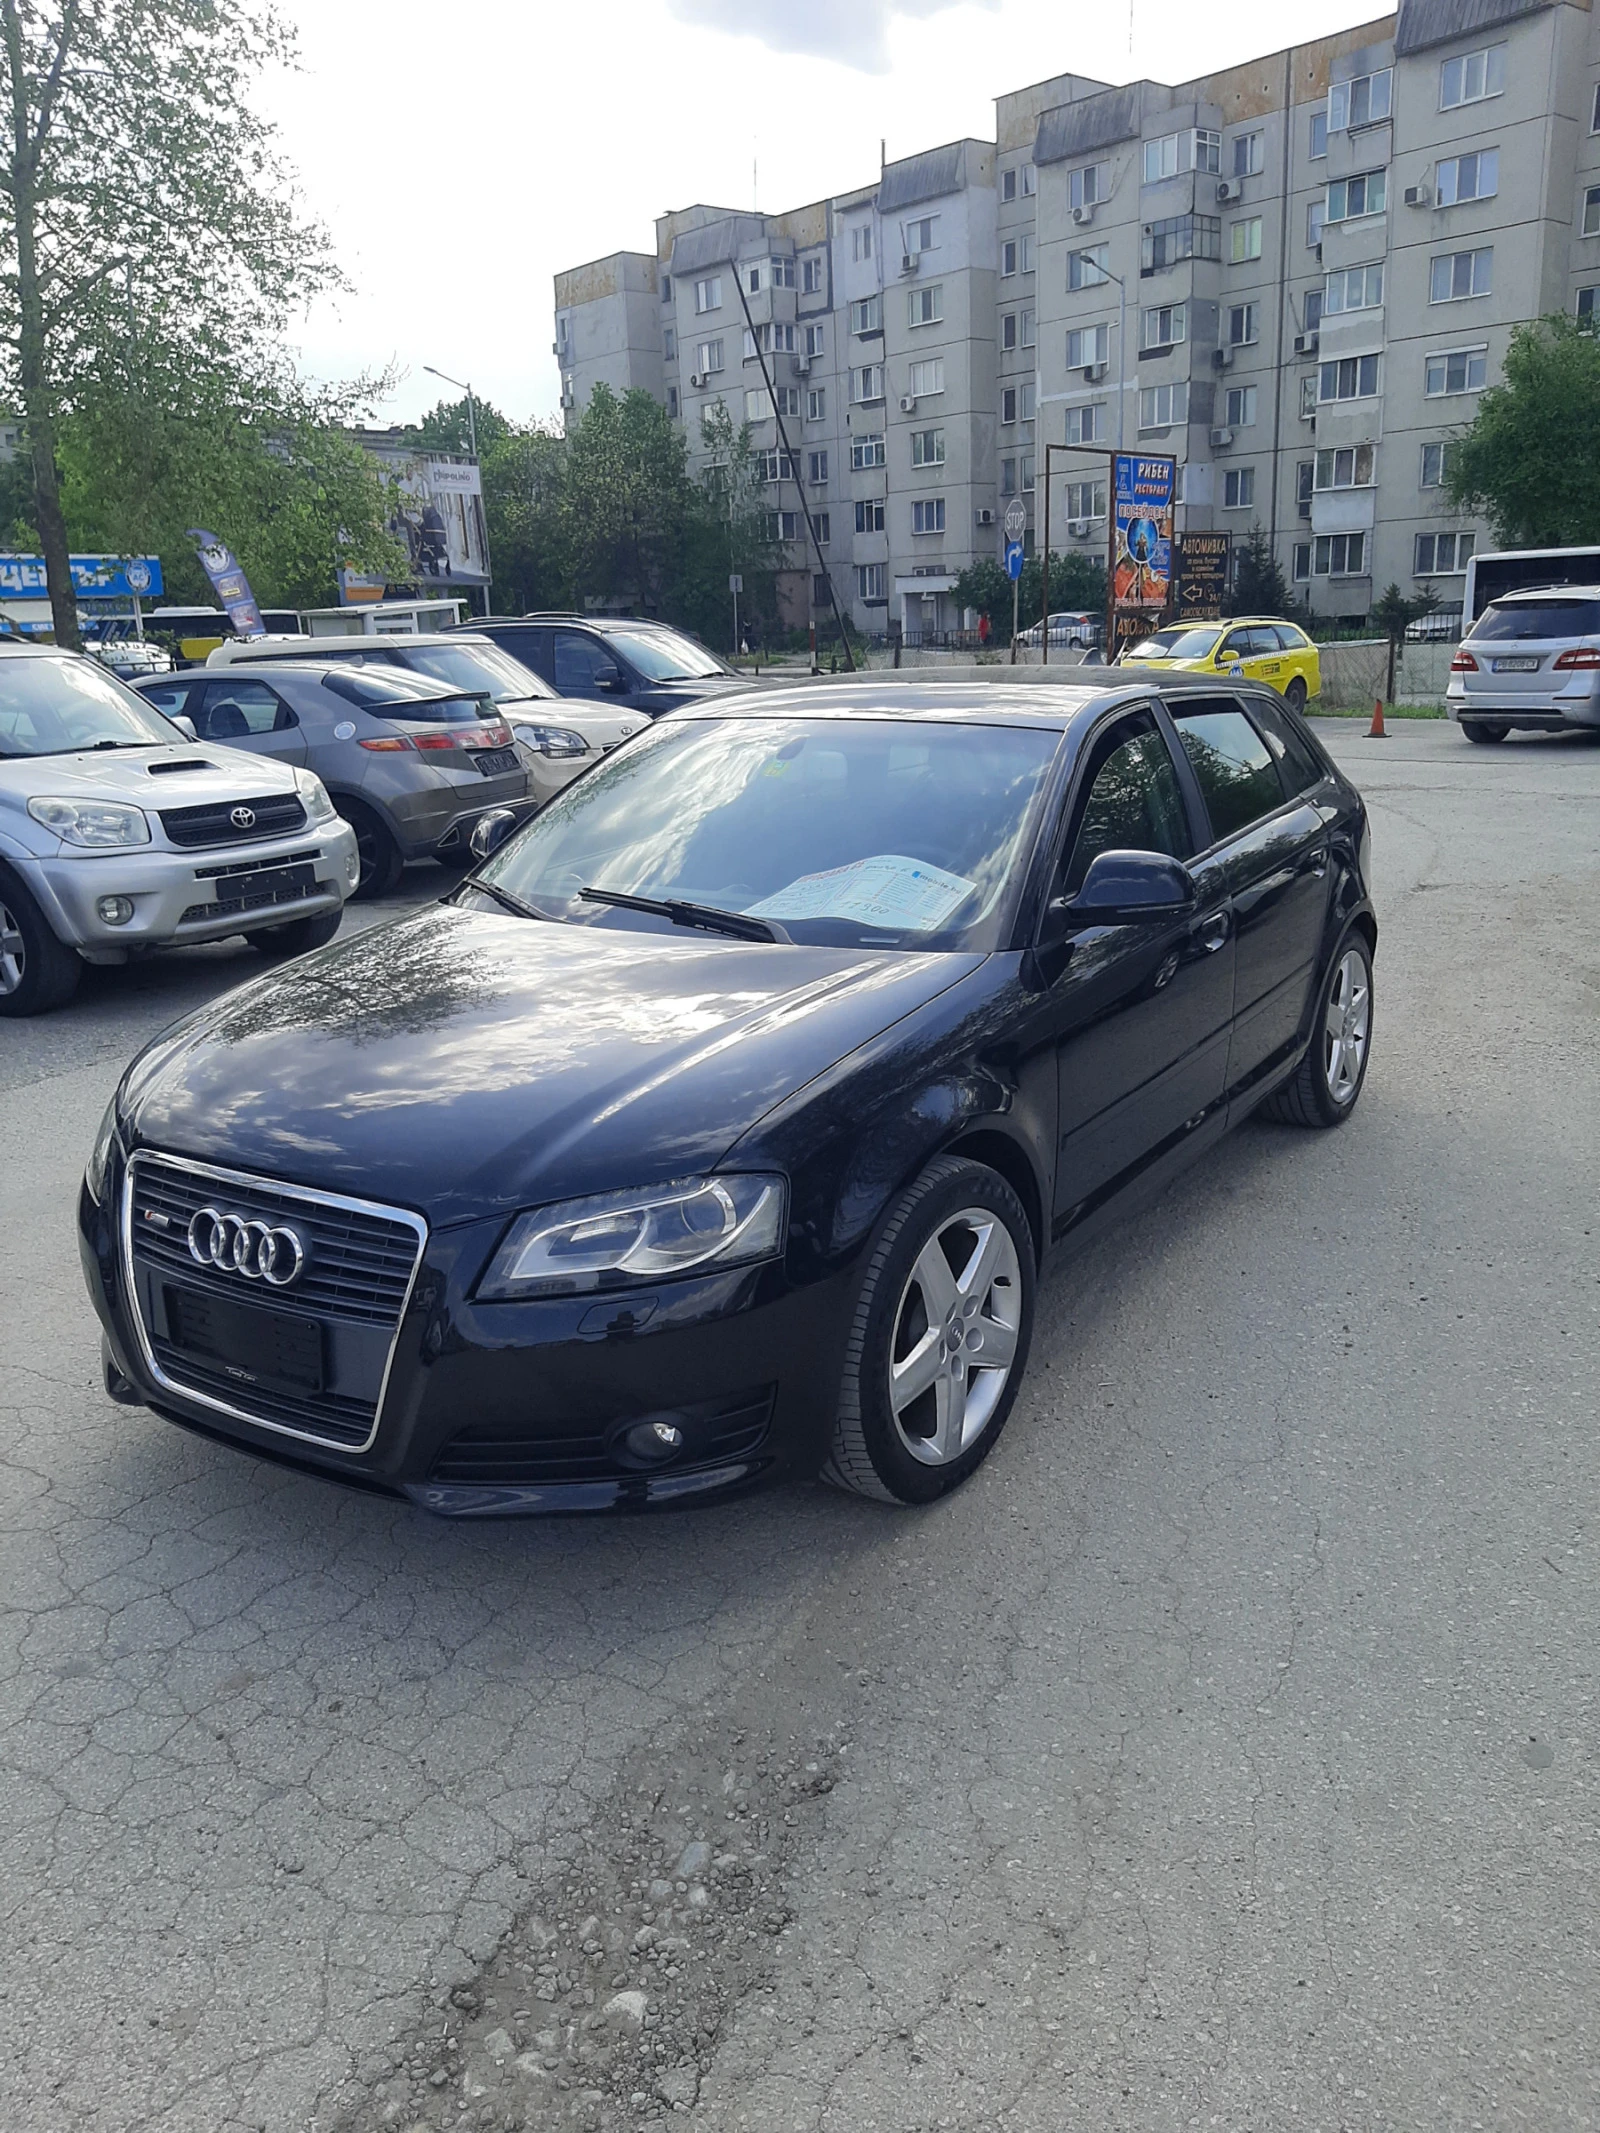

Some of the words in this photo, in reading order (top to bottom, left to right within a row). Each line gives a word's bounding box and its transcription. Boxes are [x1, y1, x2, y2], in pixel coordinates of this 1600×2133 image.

[1138, 463, 1170, 480] РИБЕН
[1134, 483, 1168, 496] РЕСТОРАНТ
[1119, 502, 1167, 519] ПОСЕЙДОН
[1006, 511, 1024, 530] STOP
[1181, 538, 1226, 554] АВТОМИВКА
